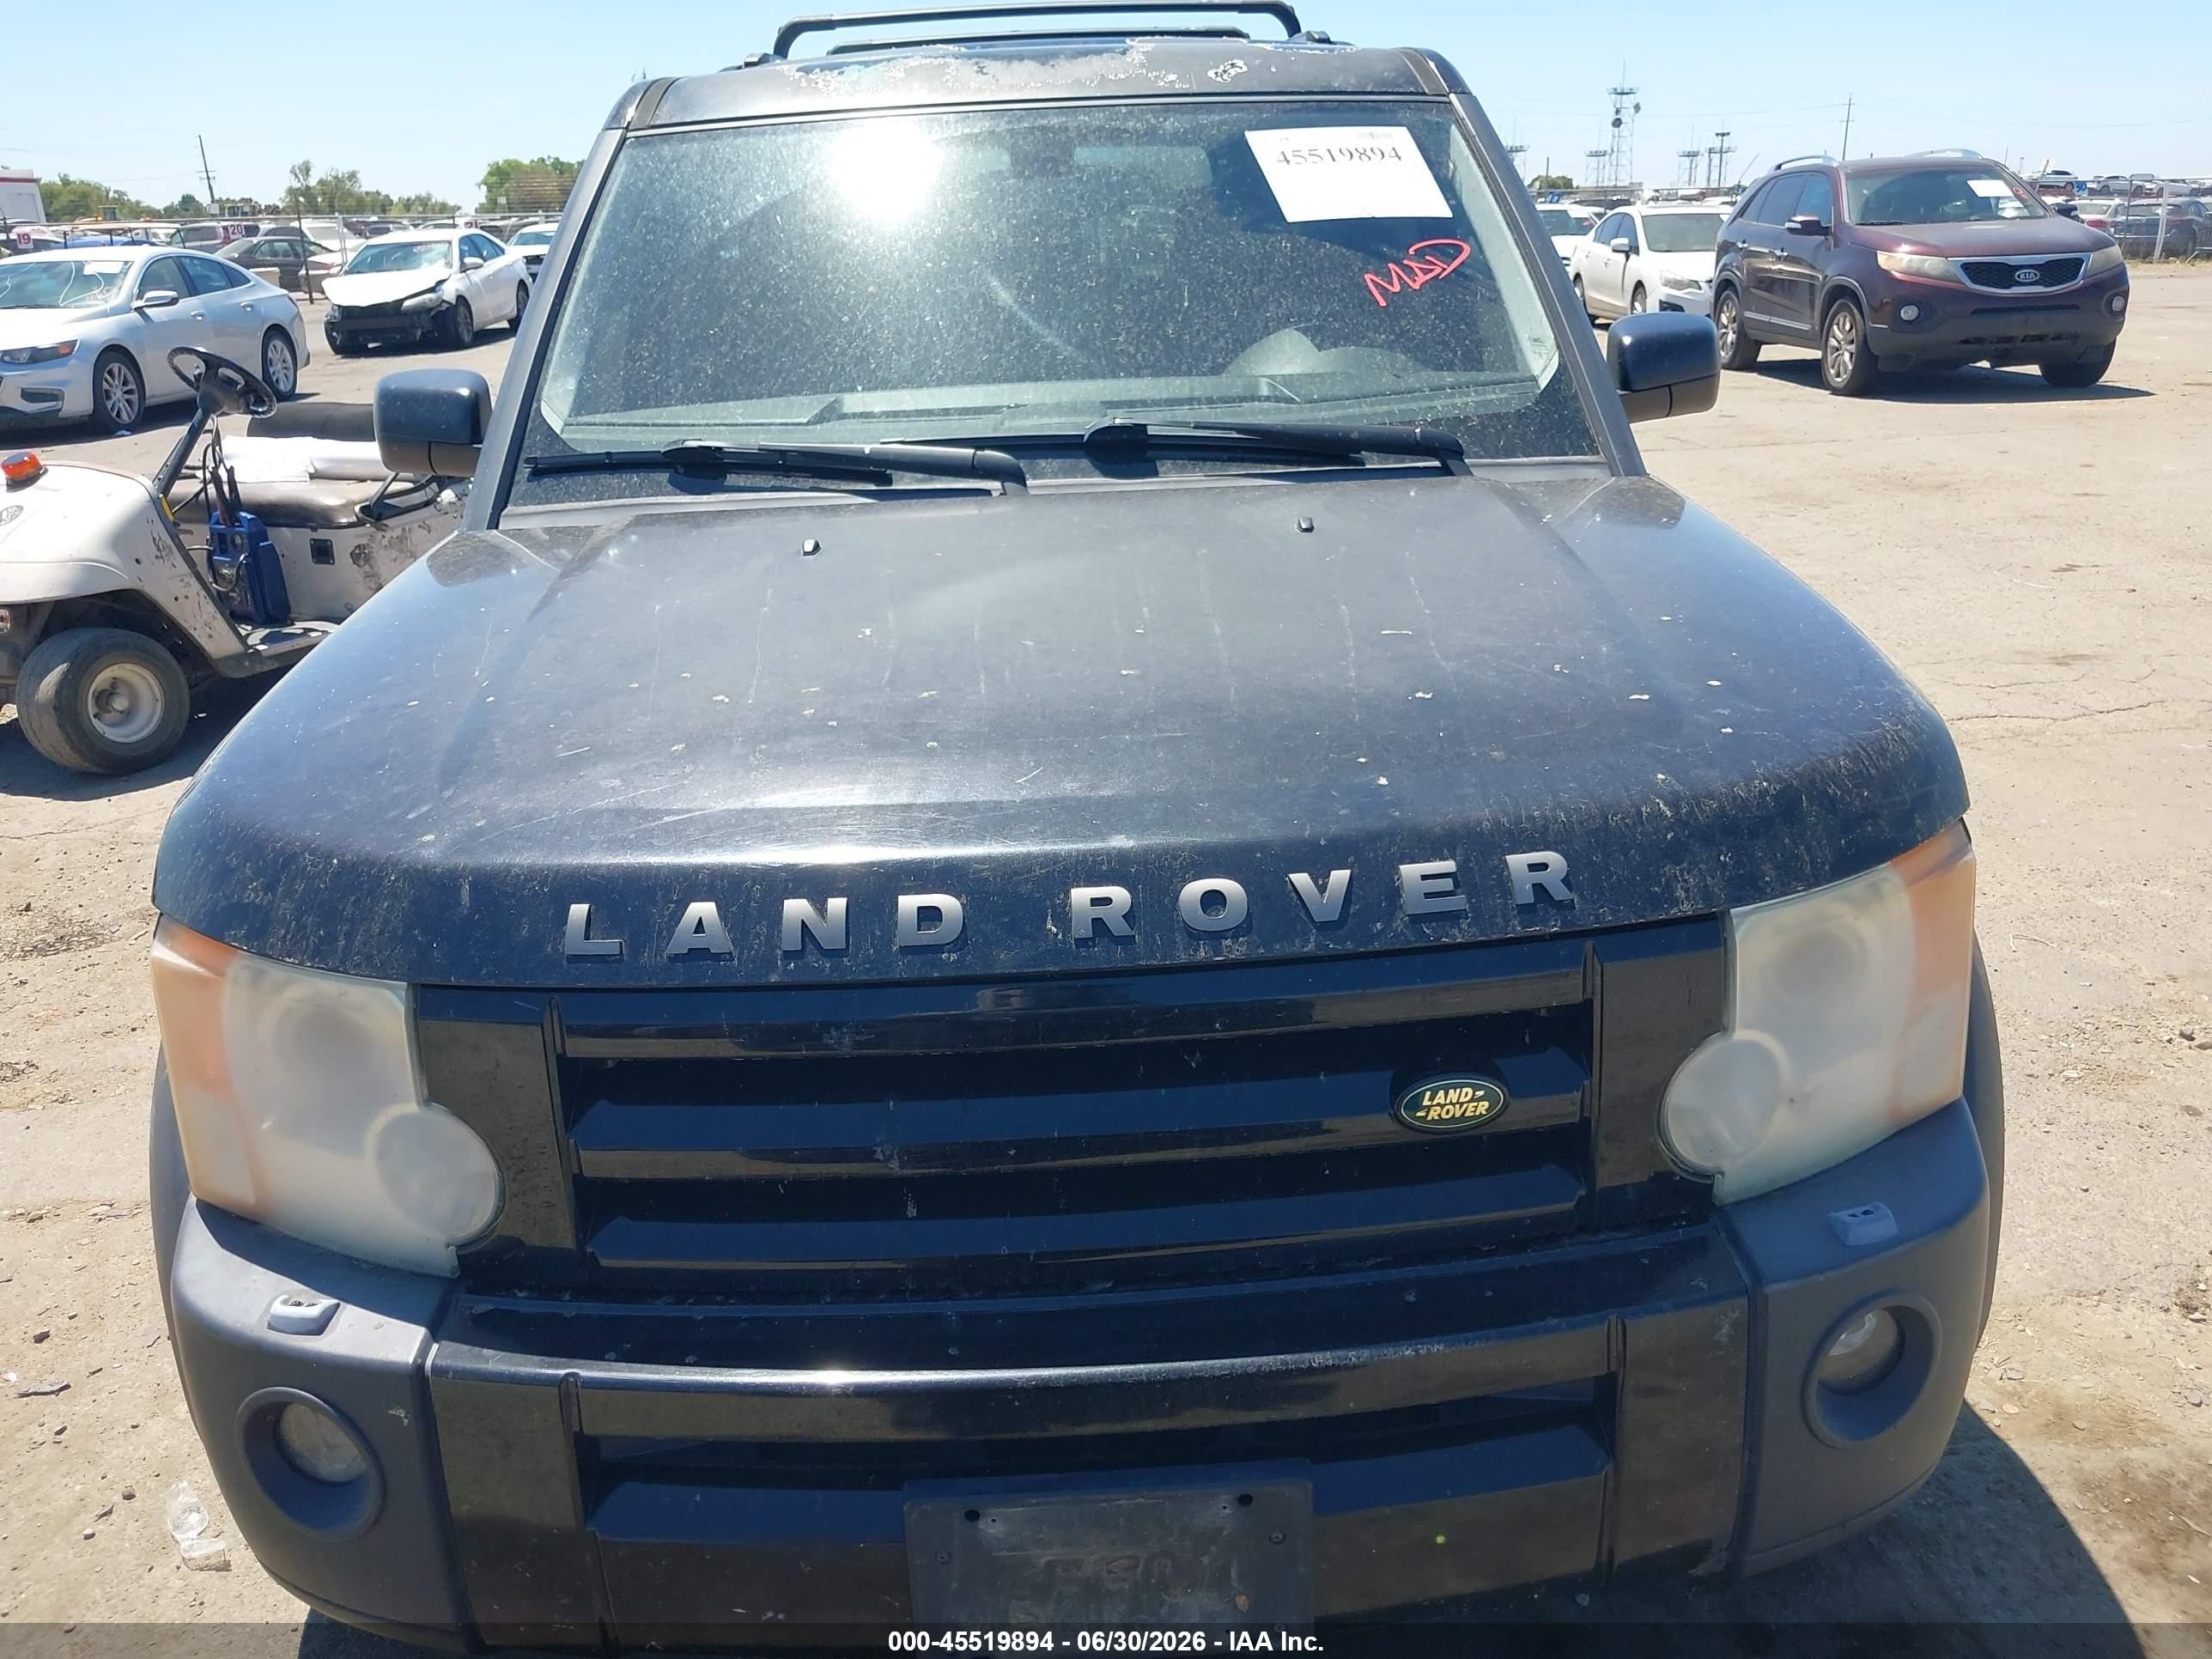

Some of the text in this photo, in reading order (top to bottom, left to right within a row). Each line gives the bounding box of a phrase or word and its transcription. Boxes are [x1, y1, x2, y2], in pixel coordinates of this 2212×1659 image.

[1277, 146, 1402, 166] 45519894
[17, 233, 31, 245] 19
[230, 223, 243, 235] 20
[1364, 239, 1471, 307] MAD
[564, 851, 1575, 957] LAND ROVER
